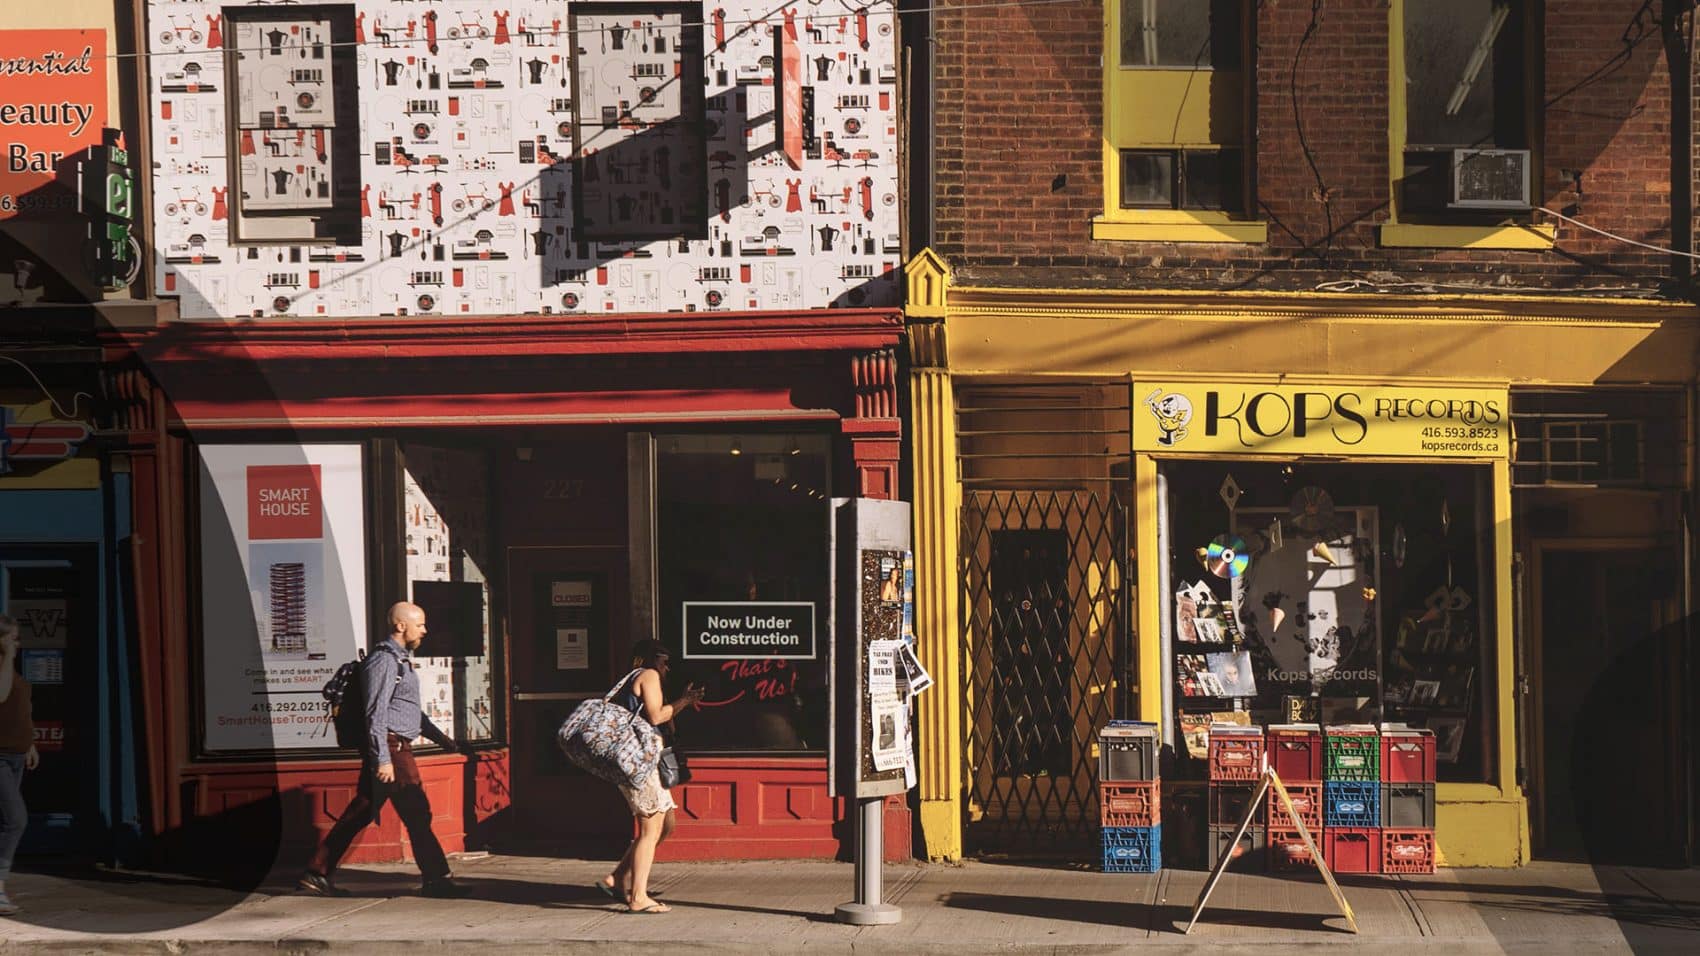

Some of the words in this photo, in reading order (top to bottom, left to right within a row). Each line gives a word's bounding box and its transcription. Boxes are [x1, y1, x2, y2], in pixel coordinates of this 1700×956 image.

[8, 143, 63, 172] Bar
[1205, 391, 1368, 446] KOPS
[1375, 397, 1501, 426] RECORDS
[1421, 426, 1499, 439] 416.593.8523
[1421, 439, 1499, 452] kopsrecords.ca
[259, 488, 309, 502] SMART
[260, 502, 310, 516] HOUSE
[708, 616, 742, 629] Now
[745, 616, 792, 629] Under
[700, 631, 799, 645] Construction
[313, 667, 334, 675] what
[1267, 668, 1308, 684] Kops
[1313, 667, 1377, 681] Records
[293, 675, 322, 684] SMART
[755, 671, 798, 700] Us!
[251, 702, 329, 713] 416.292.0219
